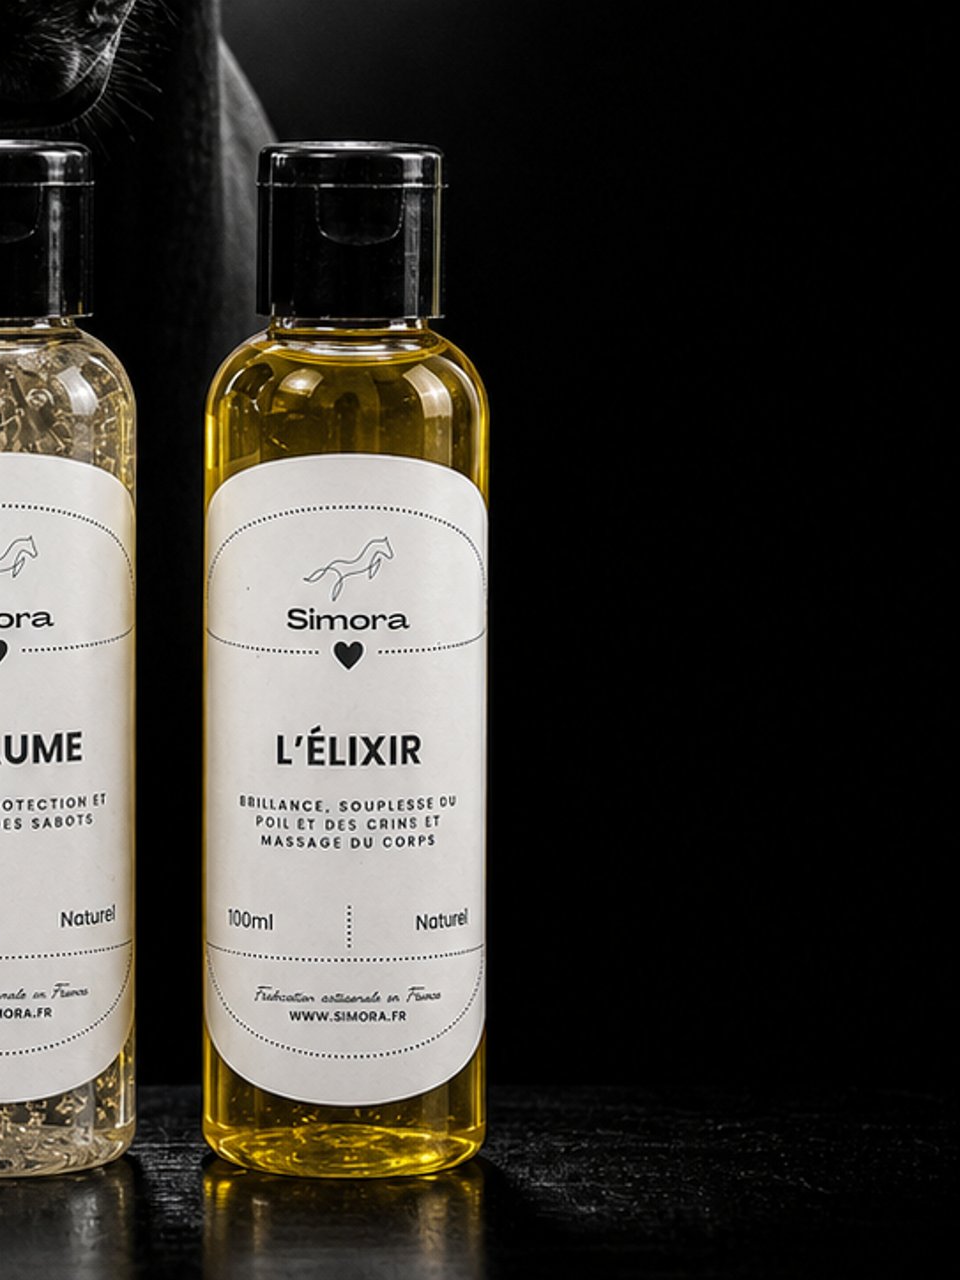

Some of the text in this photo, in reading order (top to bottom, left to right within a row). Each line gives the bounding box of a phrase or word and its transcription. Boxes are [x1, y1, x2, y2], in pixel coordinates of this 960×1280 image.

[287, 608, 410, 630] Simora
[93, 793, 105, 806] ET
[339, 797, 433, 812] SOUPLESSE
[440, 796, 456, 807] DU
[32, 813, 92, 829] SABOTS
[256, 815, 289, 829] POIL
[297, 818, 315, 830] ET
[325, 819, 356, 831] DES
[425, 815, 439, 827] ET
[261, 834, 435, 849] MASSAGE DU CORPS
[61, 904, 115, 928] Naturel
[228, 909, 273, 930] 100ml
[416, 908, 467, 930] Naturel
[289, 1011, 406, 1022] WWW.SIMORA.FR
